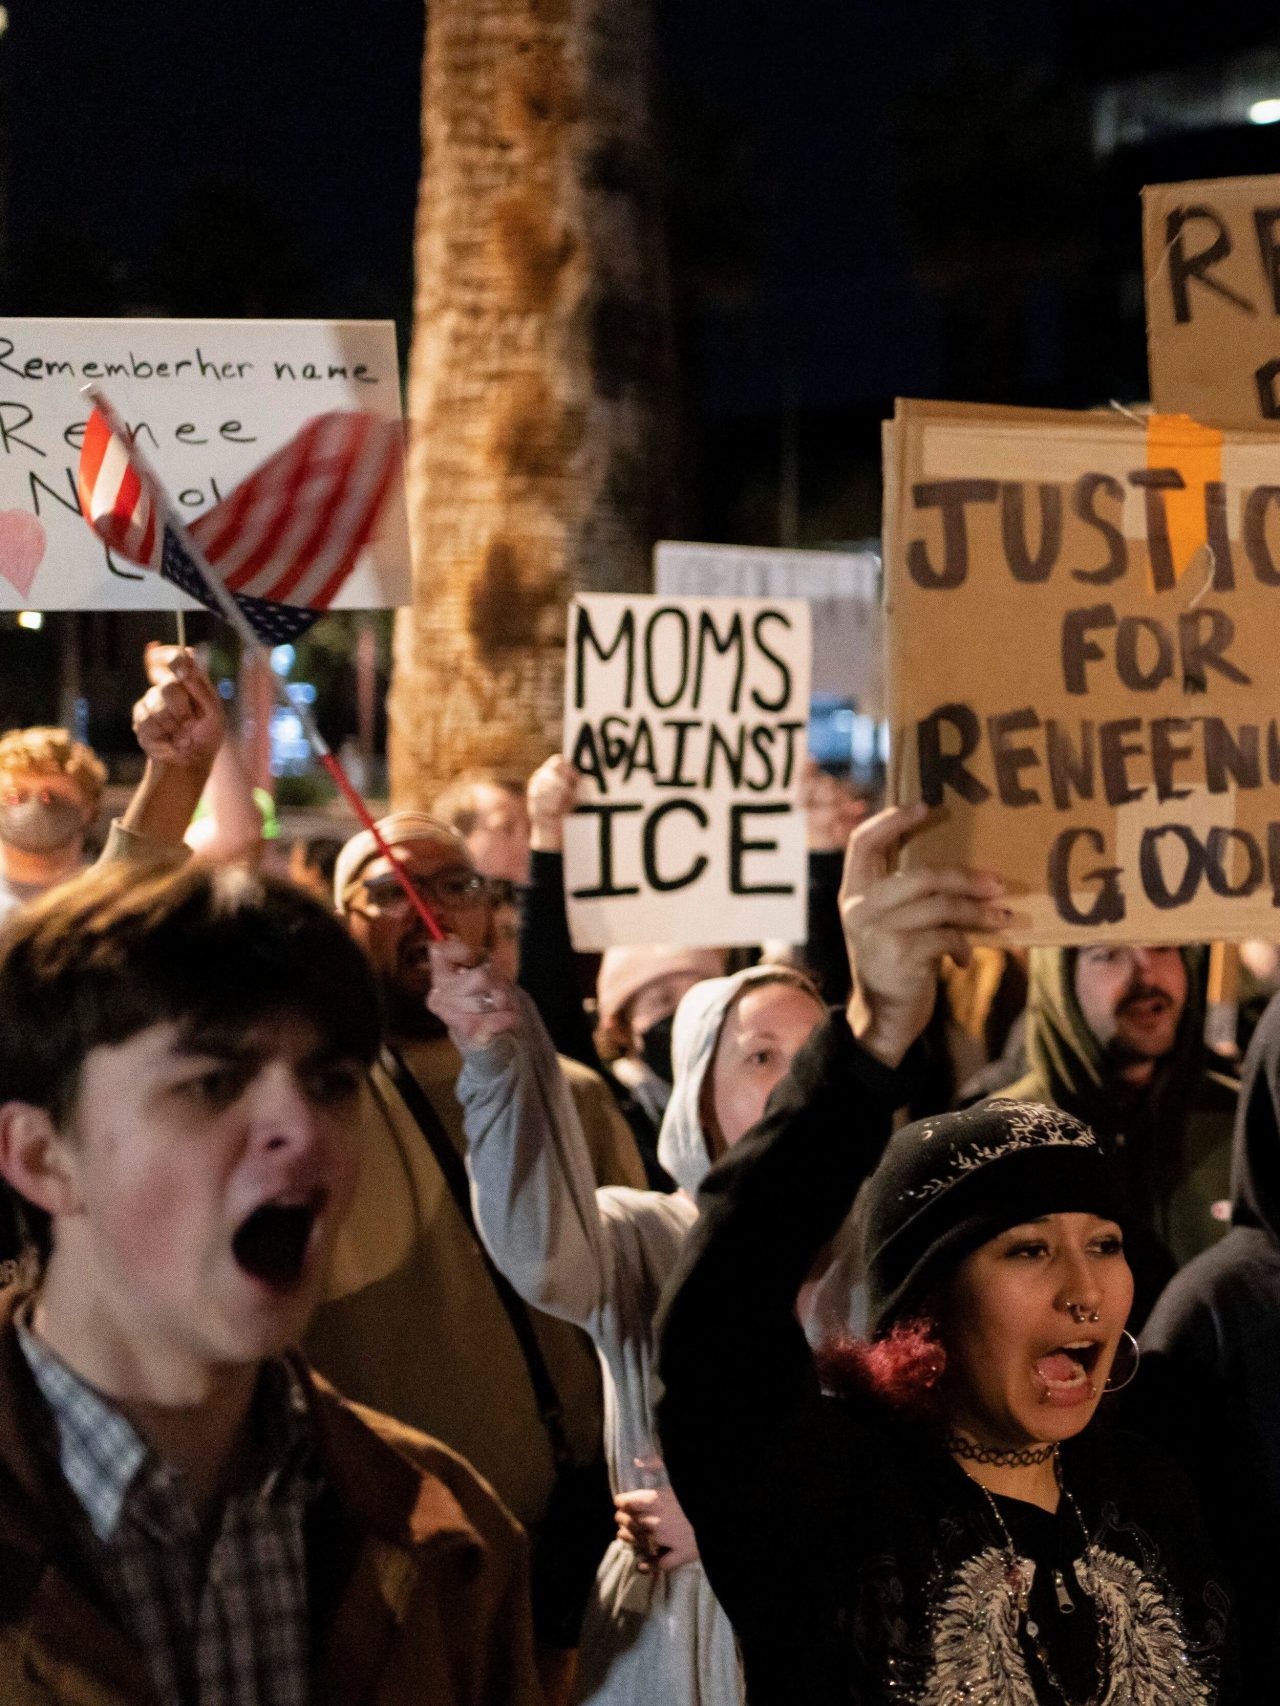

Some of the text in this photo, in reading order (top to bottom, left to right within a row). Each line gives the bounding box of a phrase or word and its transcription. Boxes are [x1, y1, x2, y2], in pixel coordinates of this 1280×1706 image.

[273, 361, 379, 384] name
[575, 603, 794, 714] MOMS
[1061, 603, 1252, 696] FOR
[572, 716, 805, 794] AGAINST
[916, 703, 1197, 810] RENEE
[572, 798, 796, 899] ICE
